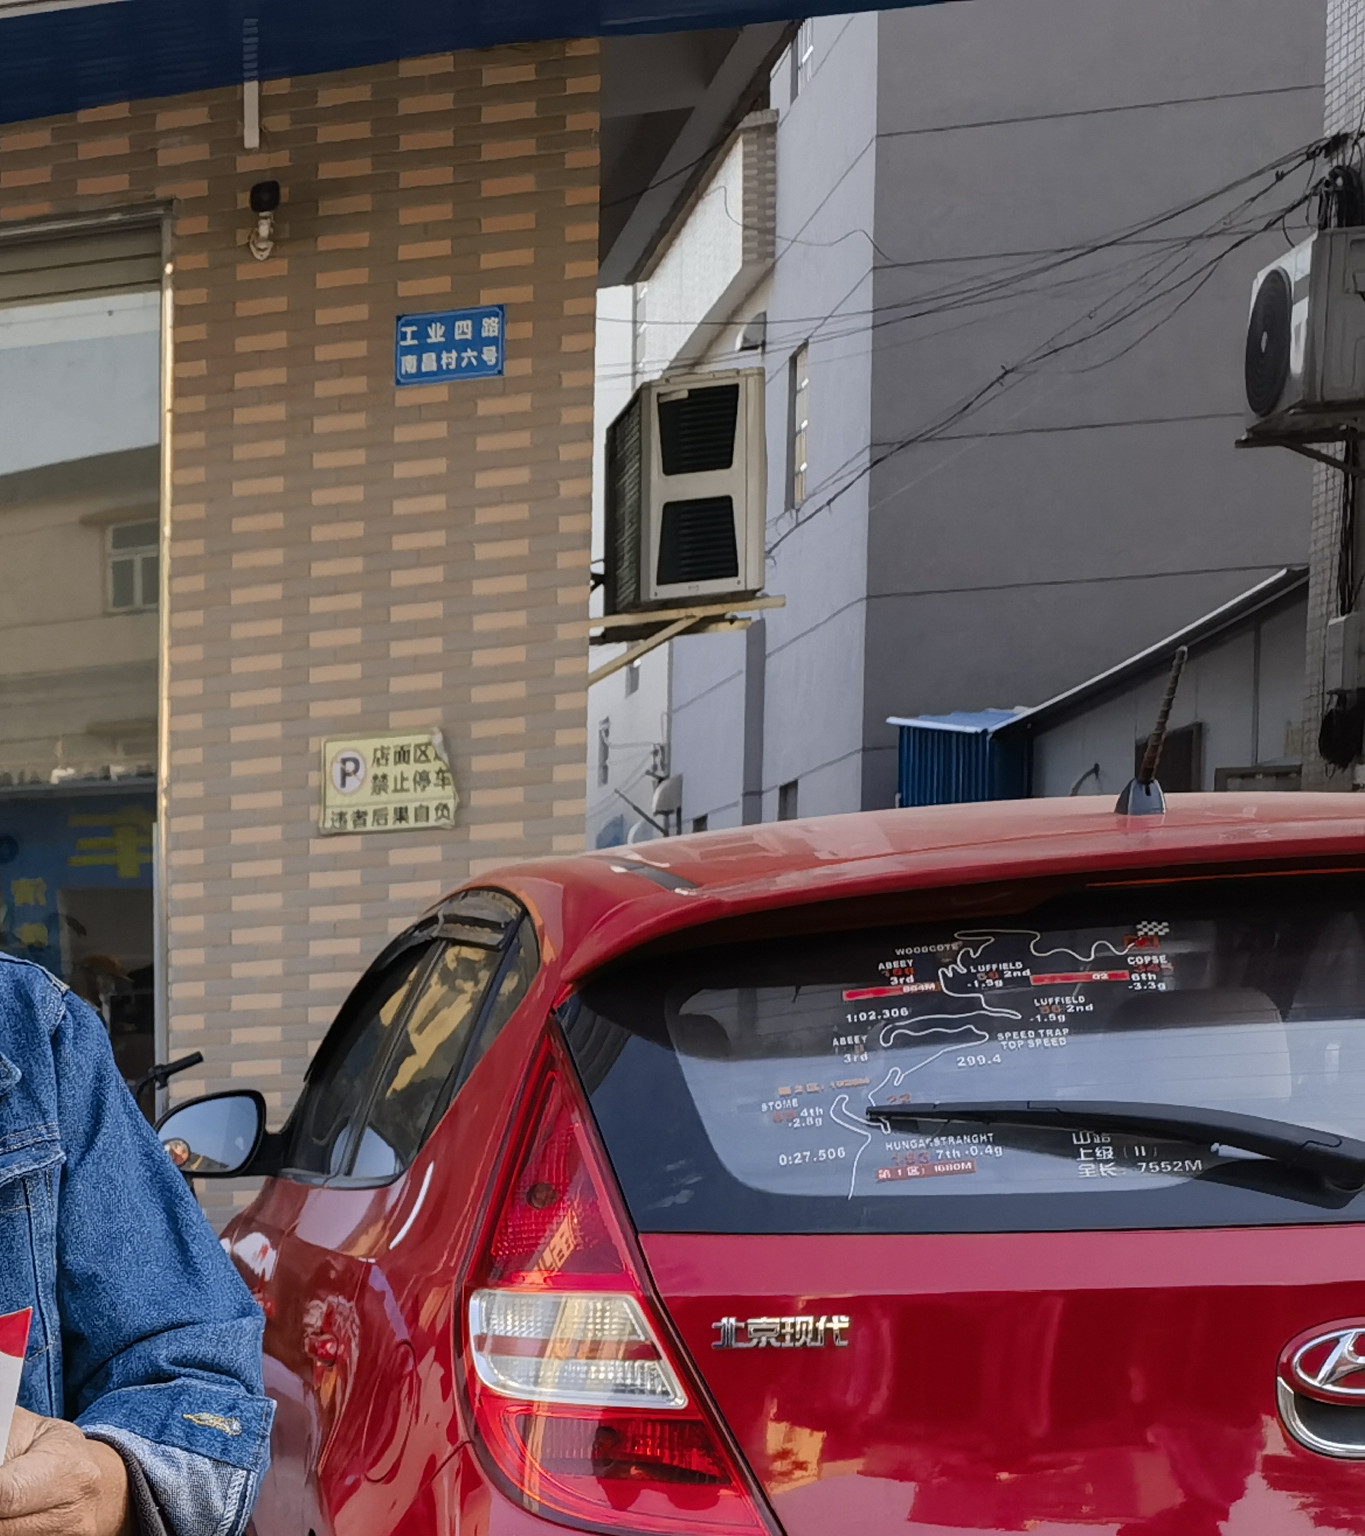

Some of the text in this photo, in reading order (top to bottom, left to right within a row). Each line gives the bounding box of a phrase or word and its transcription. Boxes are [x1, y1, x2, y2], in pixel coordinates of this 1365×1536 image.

[400, 317, 499, 346] 工业四路
[370, 767, 451, 796] 禁止停车
[330, 802, 451, 829] 违者后果自负
[1127, 954, 1168, 965] COPSE
[970, 962, 1023, 973] LUFFIELD
[1003, 969, 1031, 978] 2nd
[890, 974, 915, 985] 3rd
[1128, 981, 1167, 991] -3.3g
[1033, 996, 1086, 1007] LUFFIELD
[1065, 1003, 1094, 1013] 2nd
[846, 1007, 909, 1023] 1:02.306
[997, 1028, 1069, 1041] SPEED TRAP
[1001, 1037, 1067, 1050] TOP SPEED
[844, 1052, 868, 1063] 3rd
[800, 1106, 823, 1117] 4th
[778, 1147, 846, 1165] 0:27.506
[936, 1149, 960, 1160] 7th
[712, 1315, 850, 1349] 北京现代
